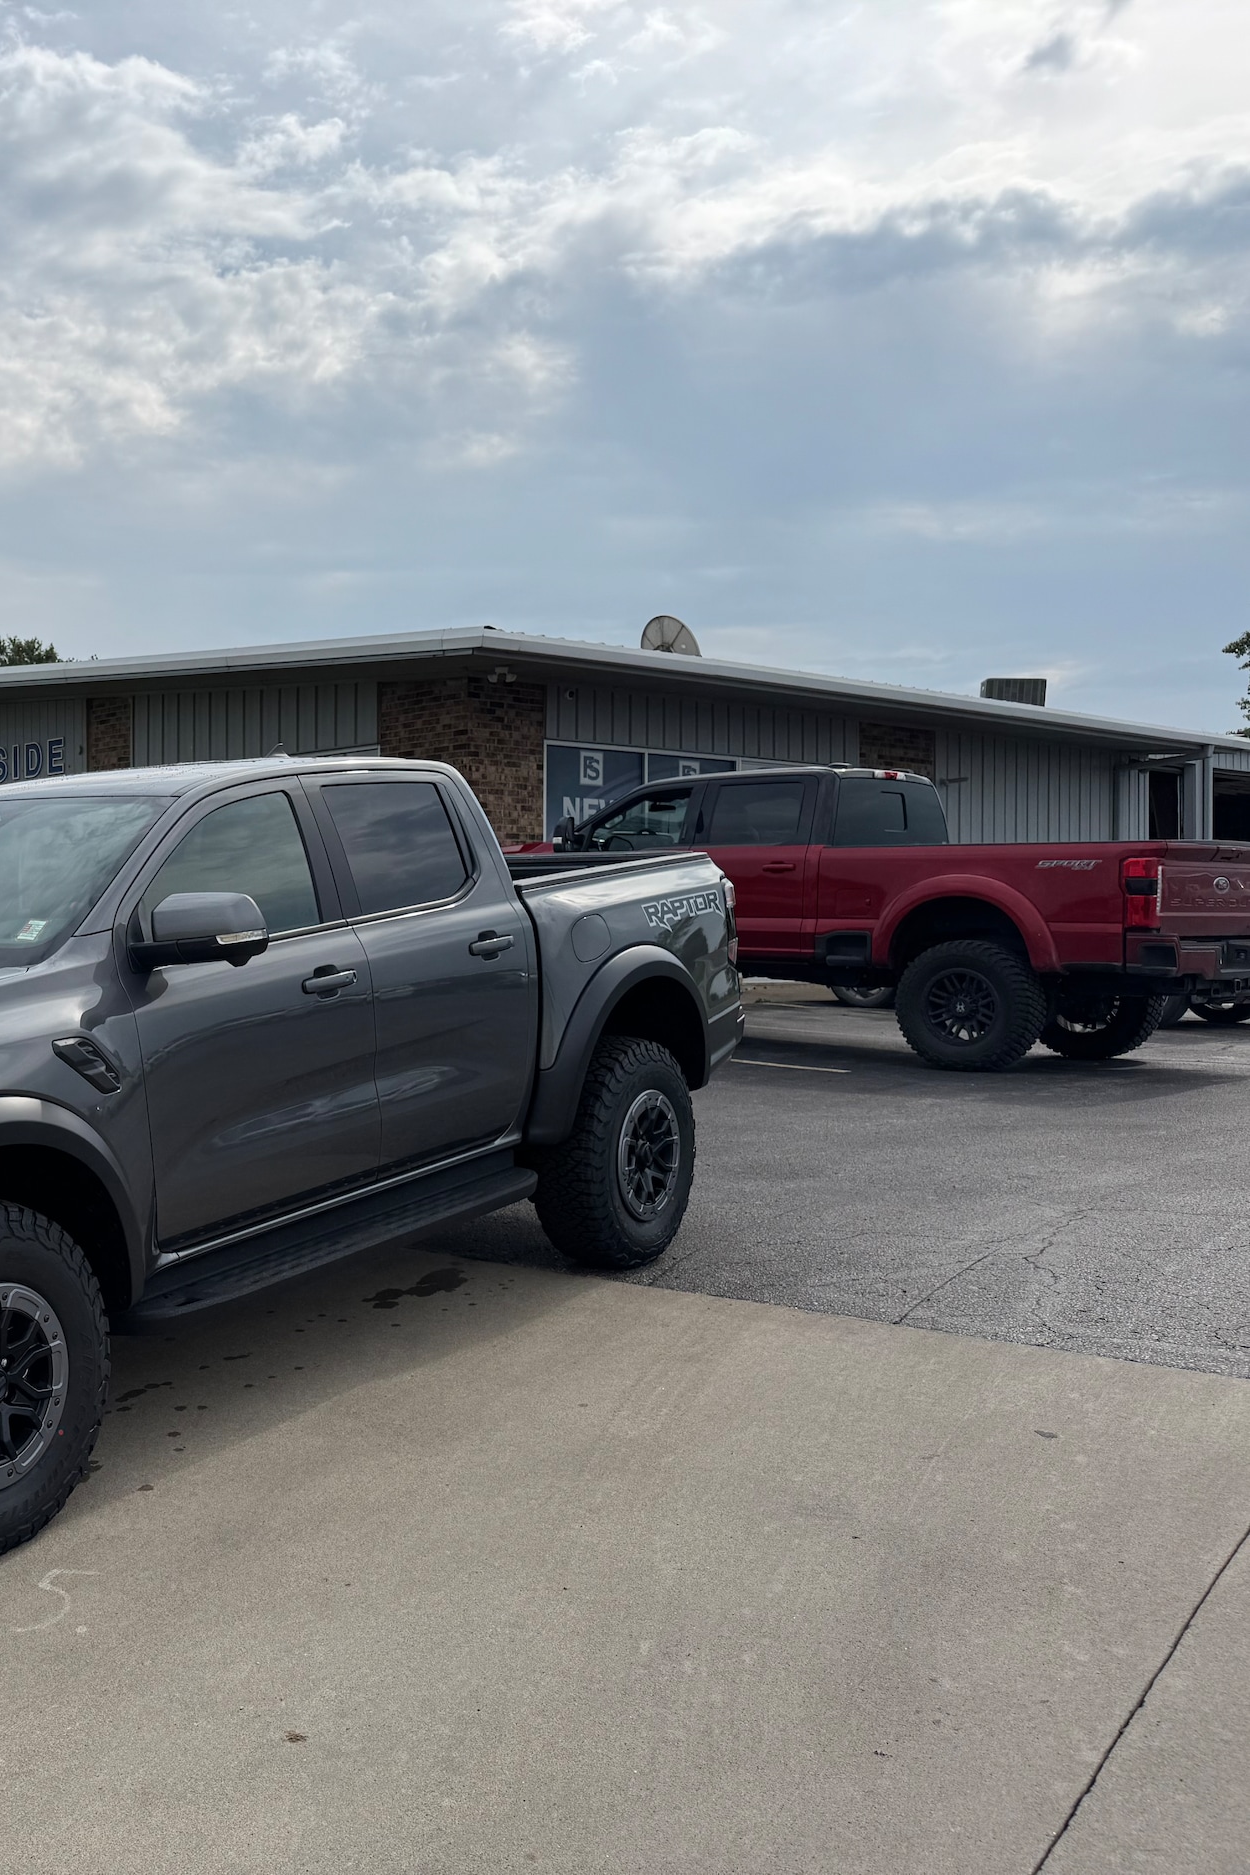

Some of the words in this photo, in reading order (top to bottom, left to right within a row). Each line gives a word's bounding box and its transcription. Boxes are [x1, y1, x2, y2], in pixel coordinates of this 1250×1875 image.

[1035, 859, 1103, 869] SPORT
[1170, 897, 1226, 907] SUPER
[641, 889, 725, 933] RAPTOR
